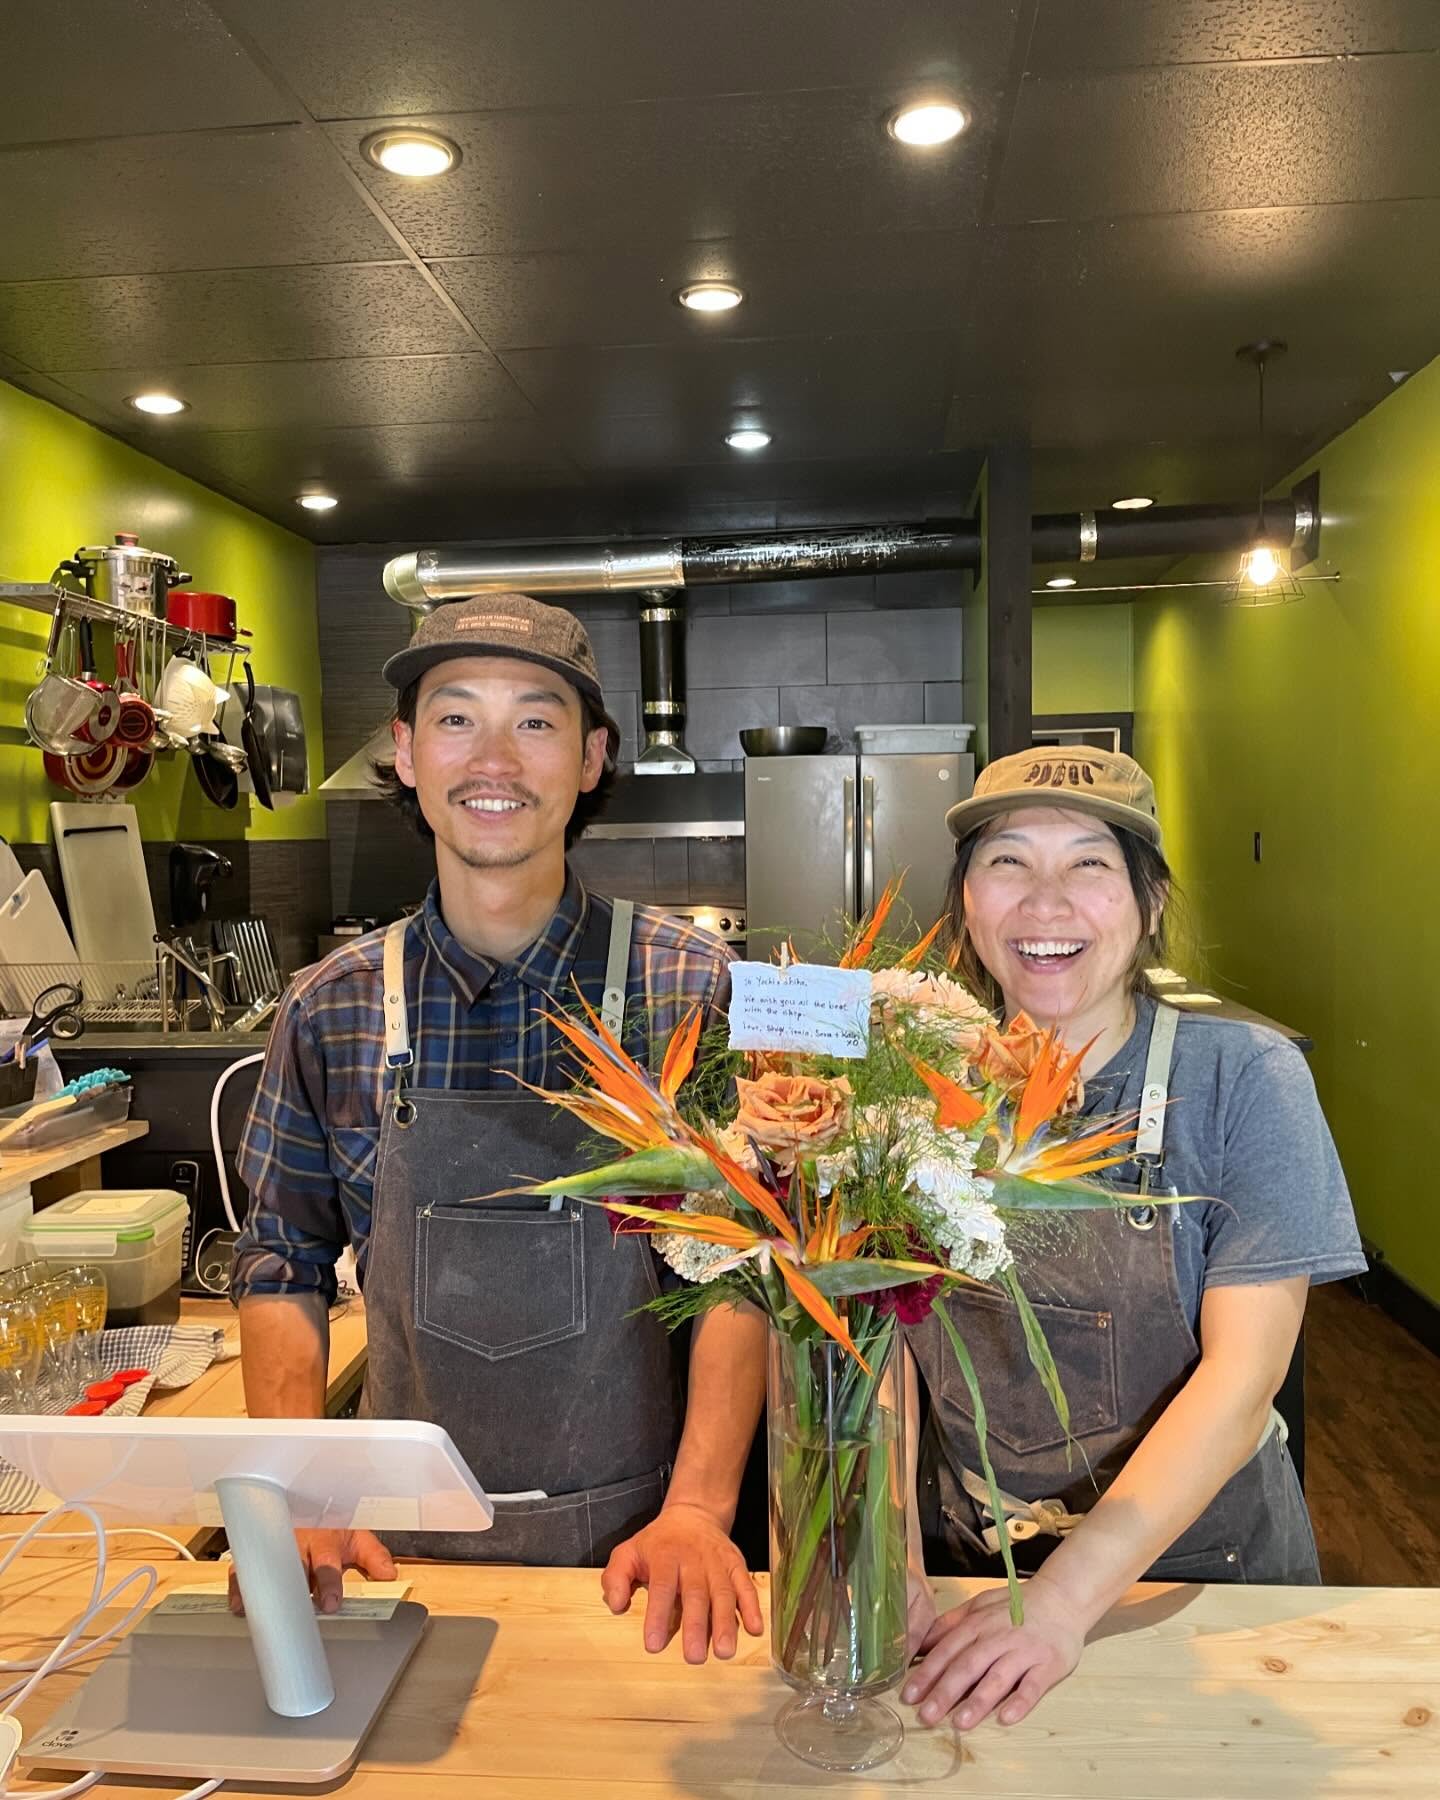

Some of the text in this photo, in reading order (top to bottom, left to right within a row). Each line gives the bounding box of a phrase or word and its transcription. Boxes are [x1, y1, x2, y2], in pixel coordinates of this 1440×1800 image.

[744, 1005, 761, 1013] with
[767, 1007, 778, 1015] the
[760, 997, 777, 1005] wish
[780, 999, 796, 1007] you
[814, 1000, 826, 1009] the
[829, 1001, 849, 1011] best
